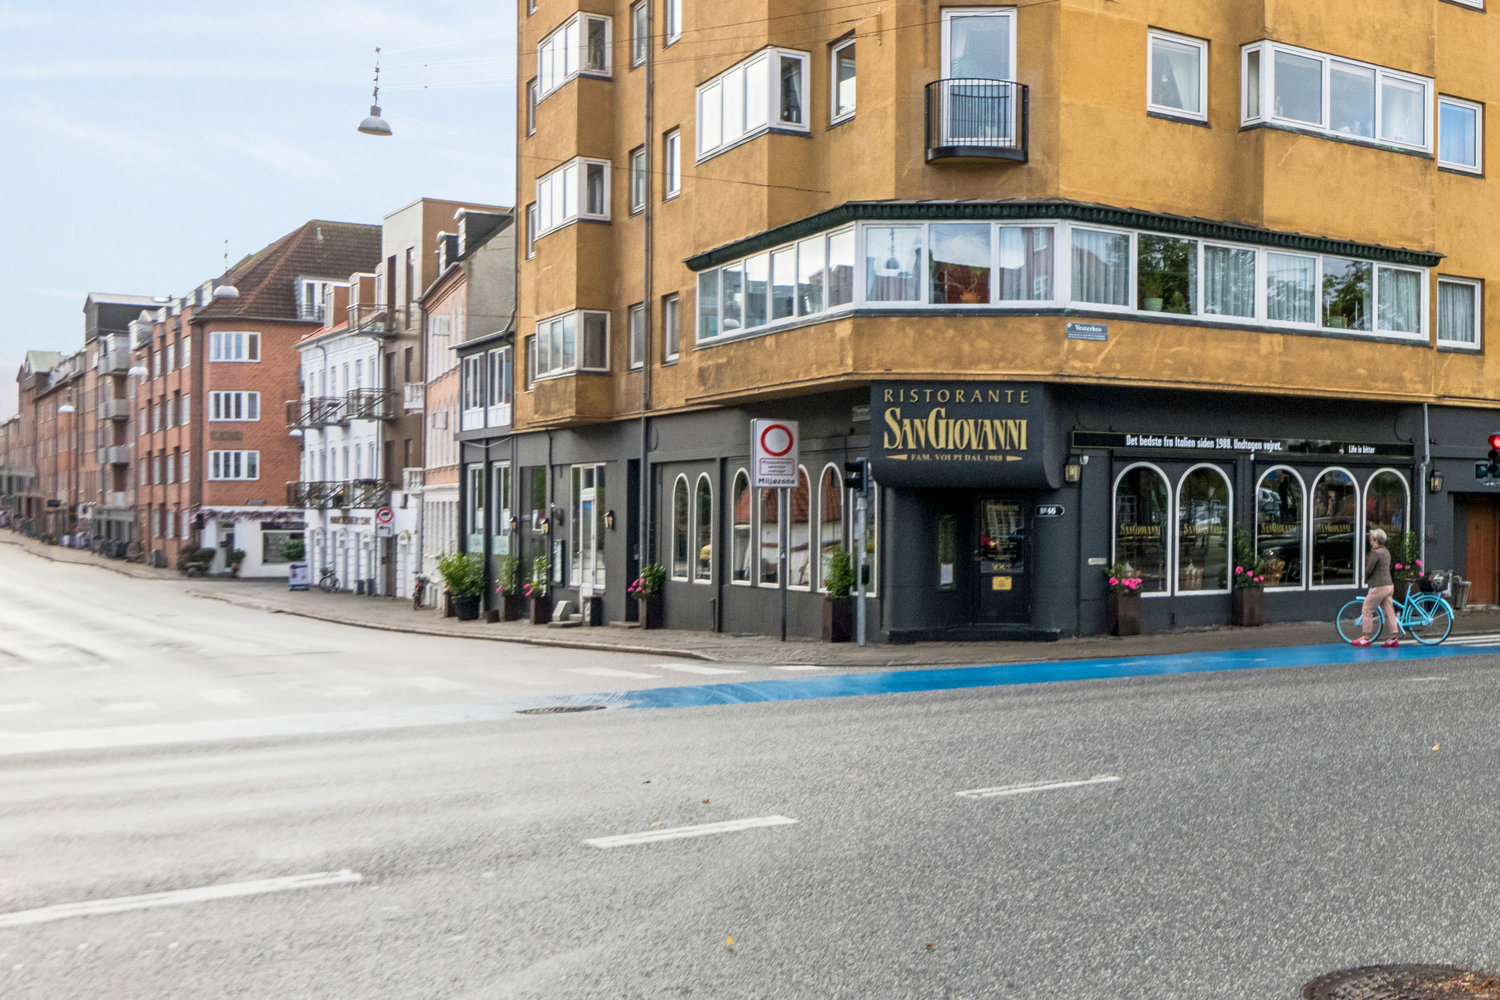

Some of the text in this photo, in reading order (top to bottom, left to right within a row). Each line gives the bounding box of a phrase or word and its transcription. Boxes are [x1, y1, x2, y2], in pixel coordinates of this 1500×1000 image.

[1075, 324, 1103, 333] Vesterbro
[884, 388, 1030, 404] RISTORANTE
[1126, 434, 1283, 452] Det bedste fra Italien siden 1988. Undtagen vejret.
[911, 453, 933, 461] FAM.
